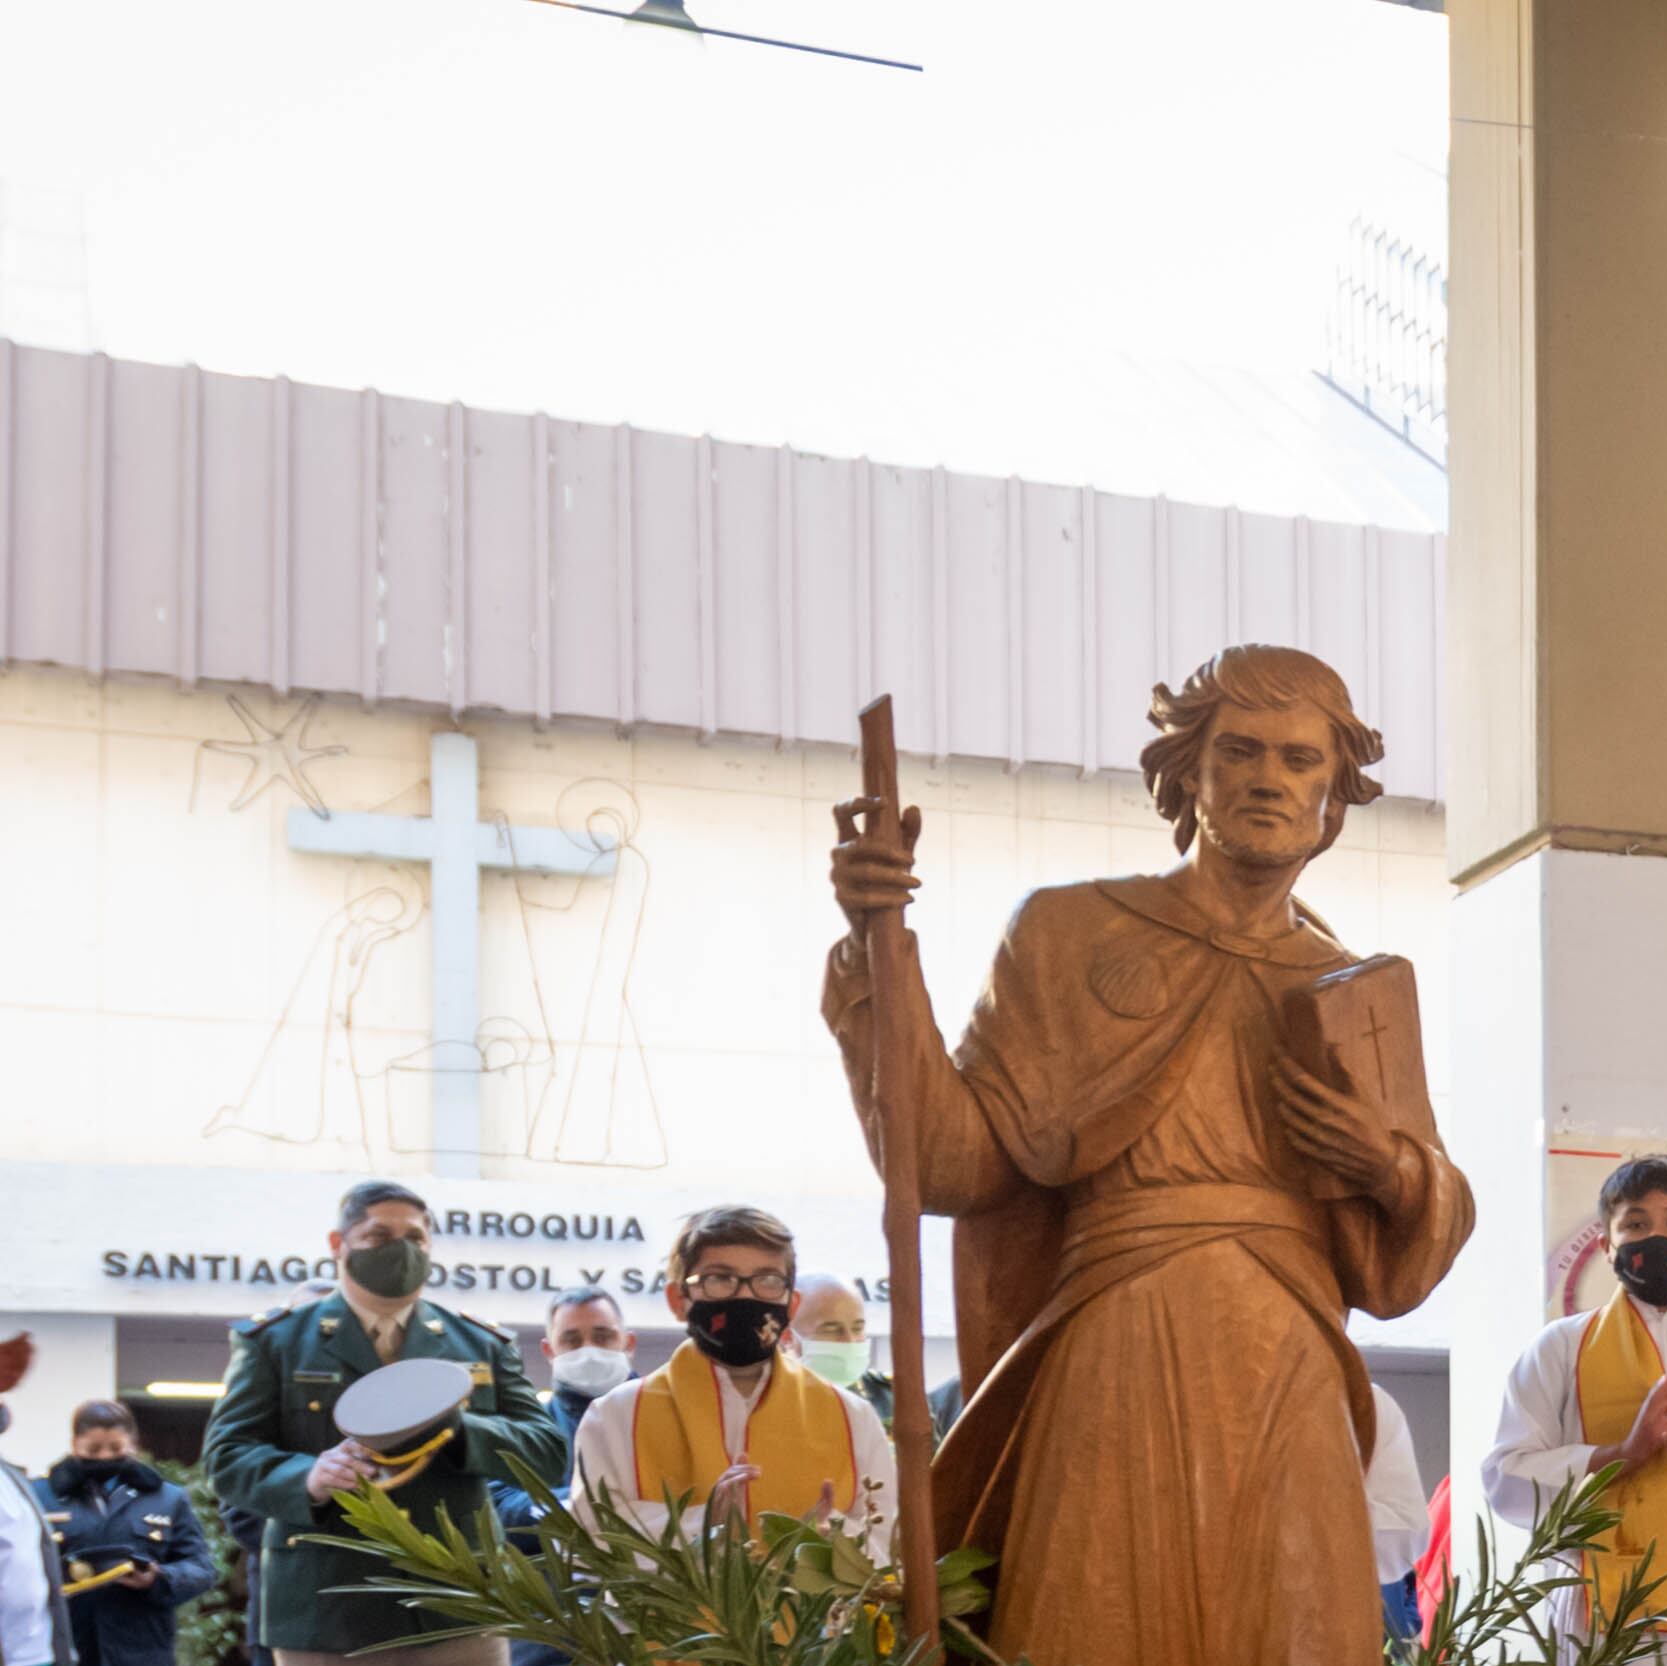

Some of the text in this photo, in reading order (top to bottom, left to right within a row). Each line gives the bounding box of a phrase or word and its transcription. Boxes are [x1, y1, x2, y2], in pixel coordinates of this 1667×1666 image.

[429, 1208, 646, 1242] RROQUIA
[424, 1262, 562, 1292] OSTOL
[620, 1268, 667, 1295] SA
